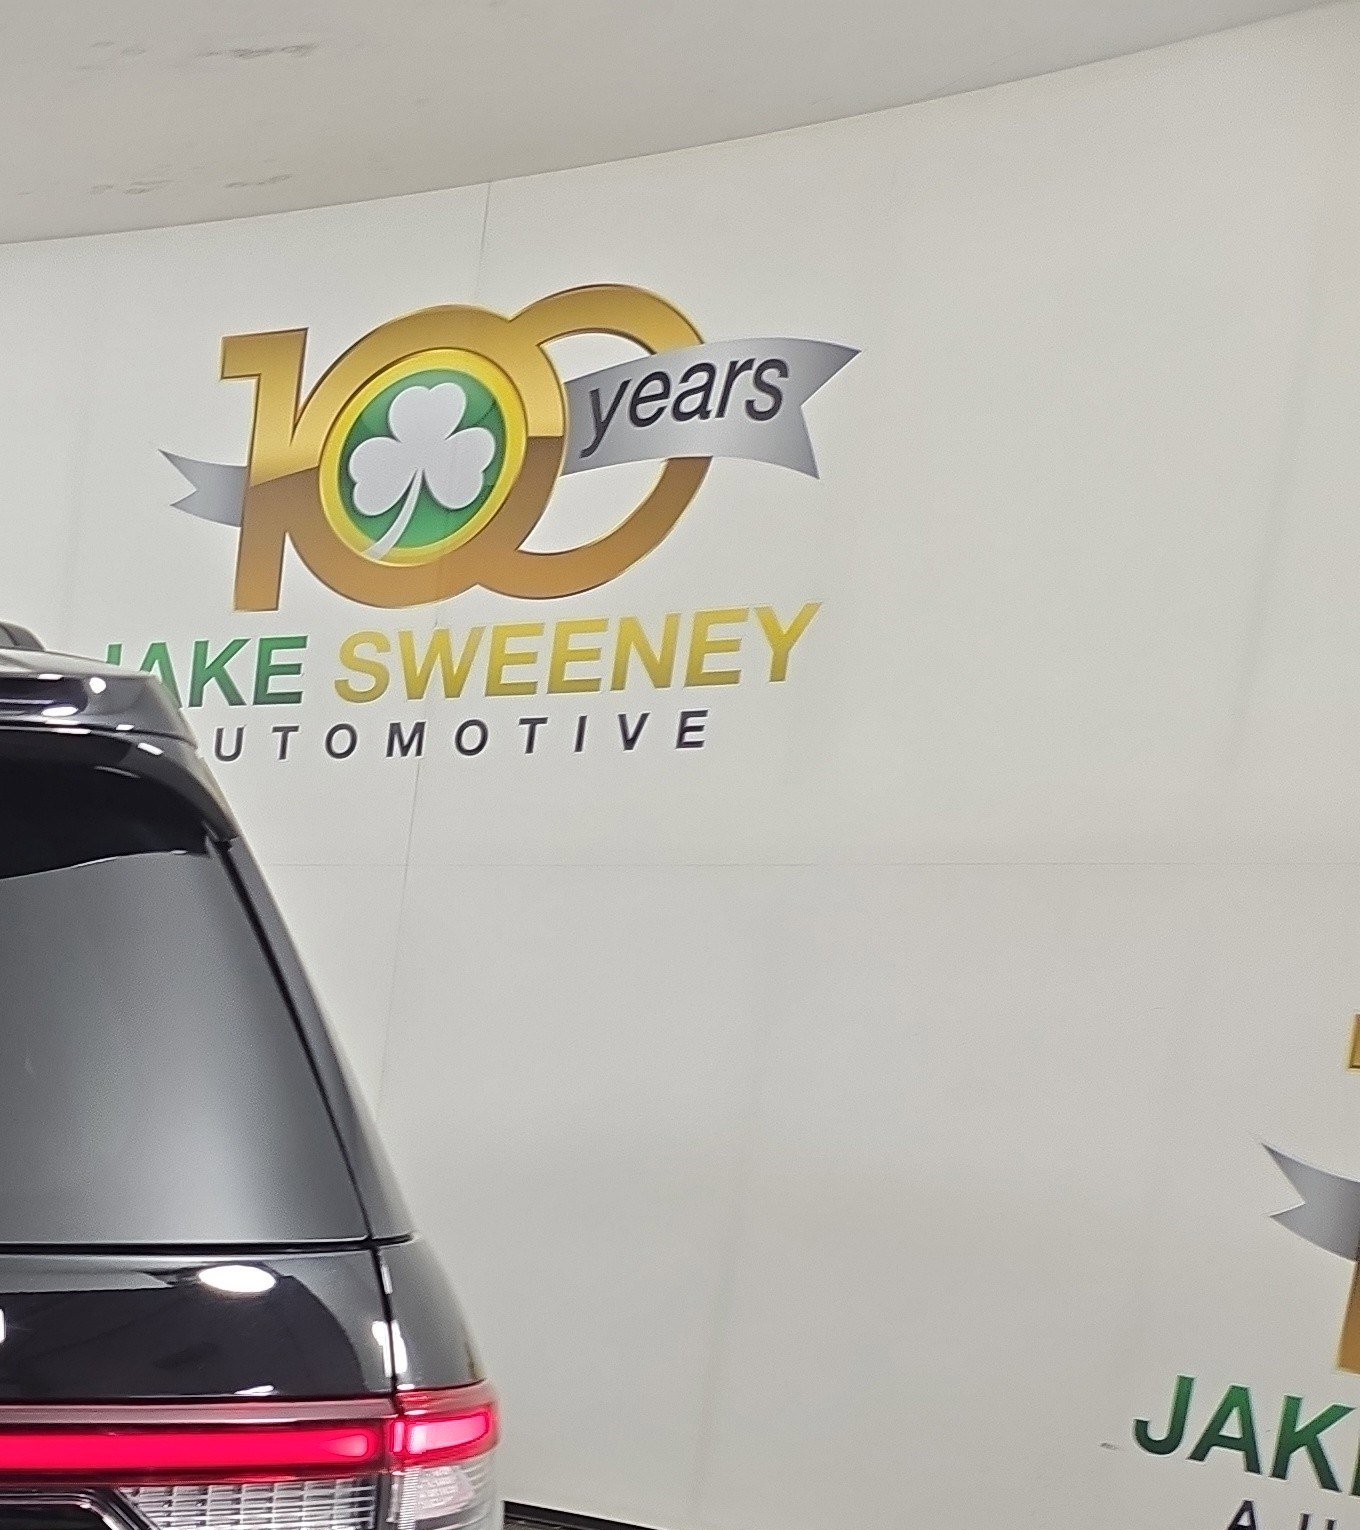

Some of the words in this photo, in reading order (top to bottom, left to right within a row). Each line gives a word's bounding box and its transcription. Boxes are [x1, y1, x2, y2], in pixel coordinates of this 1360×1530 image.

[220, 284, 714, 612] 100
[580, 351, 791, 460] years
[103, 634, 309, 710] AKE
[334, 601, 823, 704] SWEENEY
[1132, 1372, 1360, 1498] JAK
